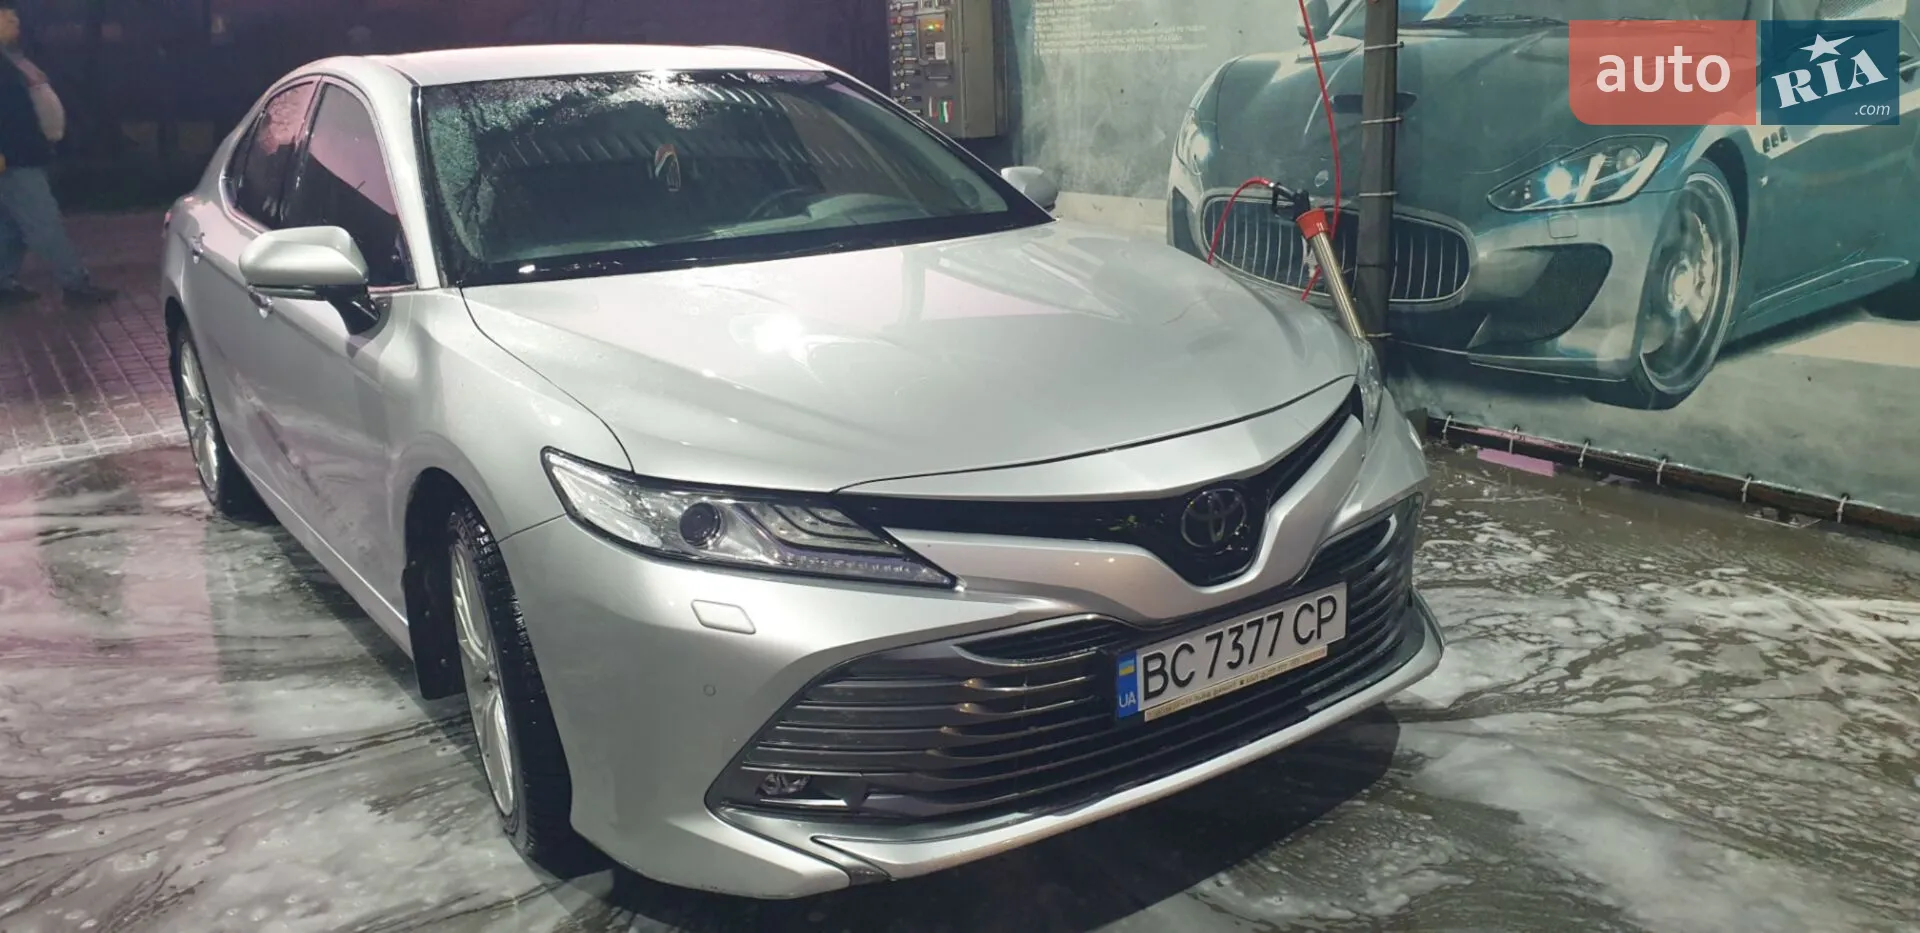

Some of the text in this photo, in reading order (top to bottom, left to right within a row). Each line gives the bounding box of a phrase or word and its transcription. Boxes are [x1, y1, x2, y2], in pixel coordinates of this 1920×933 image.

[1142, 643, 1195, 701] BC
[1205, 611, 1284, 679] 7377
[1293, 595, 1337, 645] CP
[1119, 691, 1136, 708] UA
